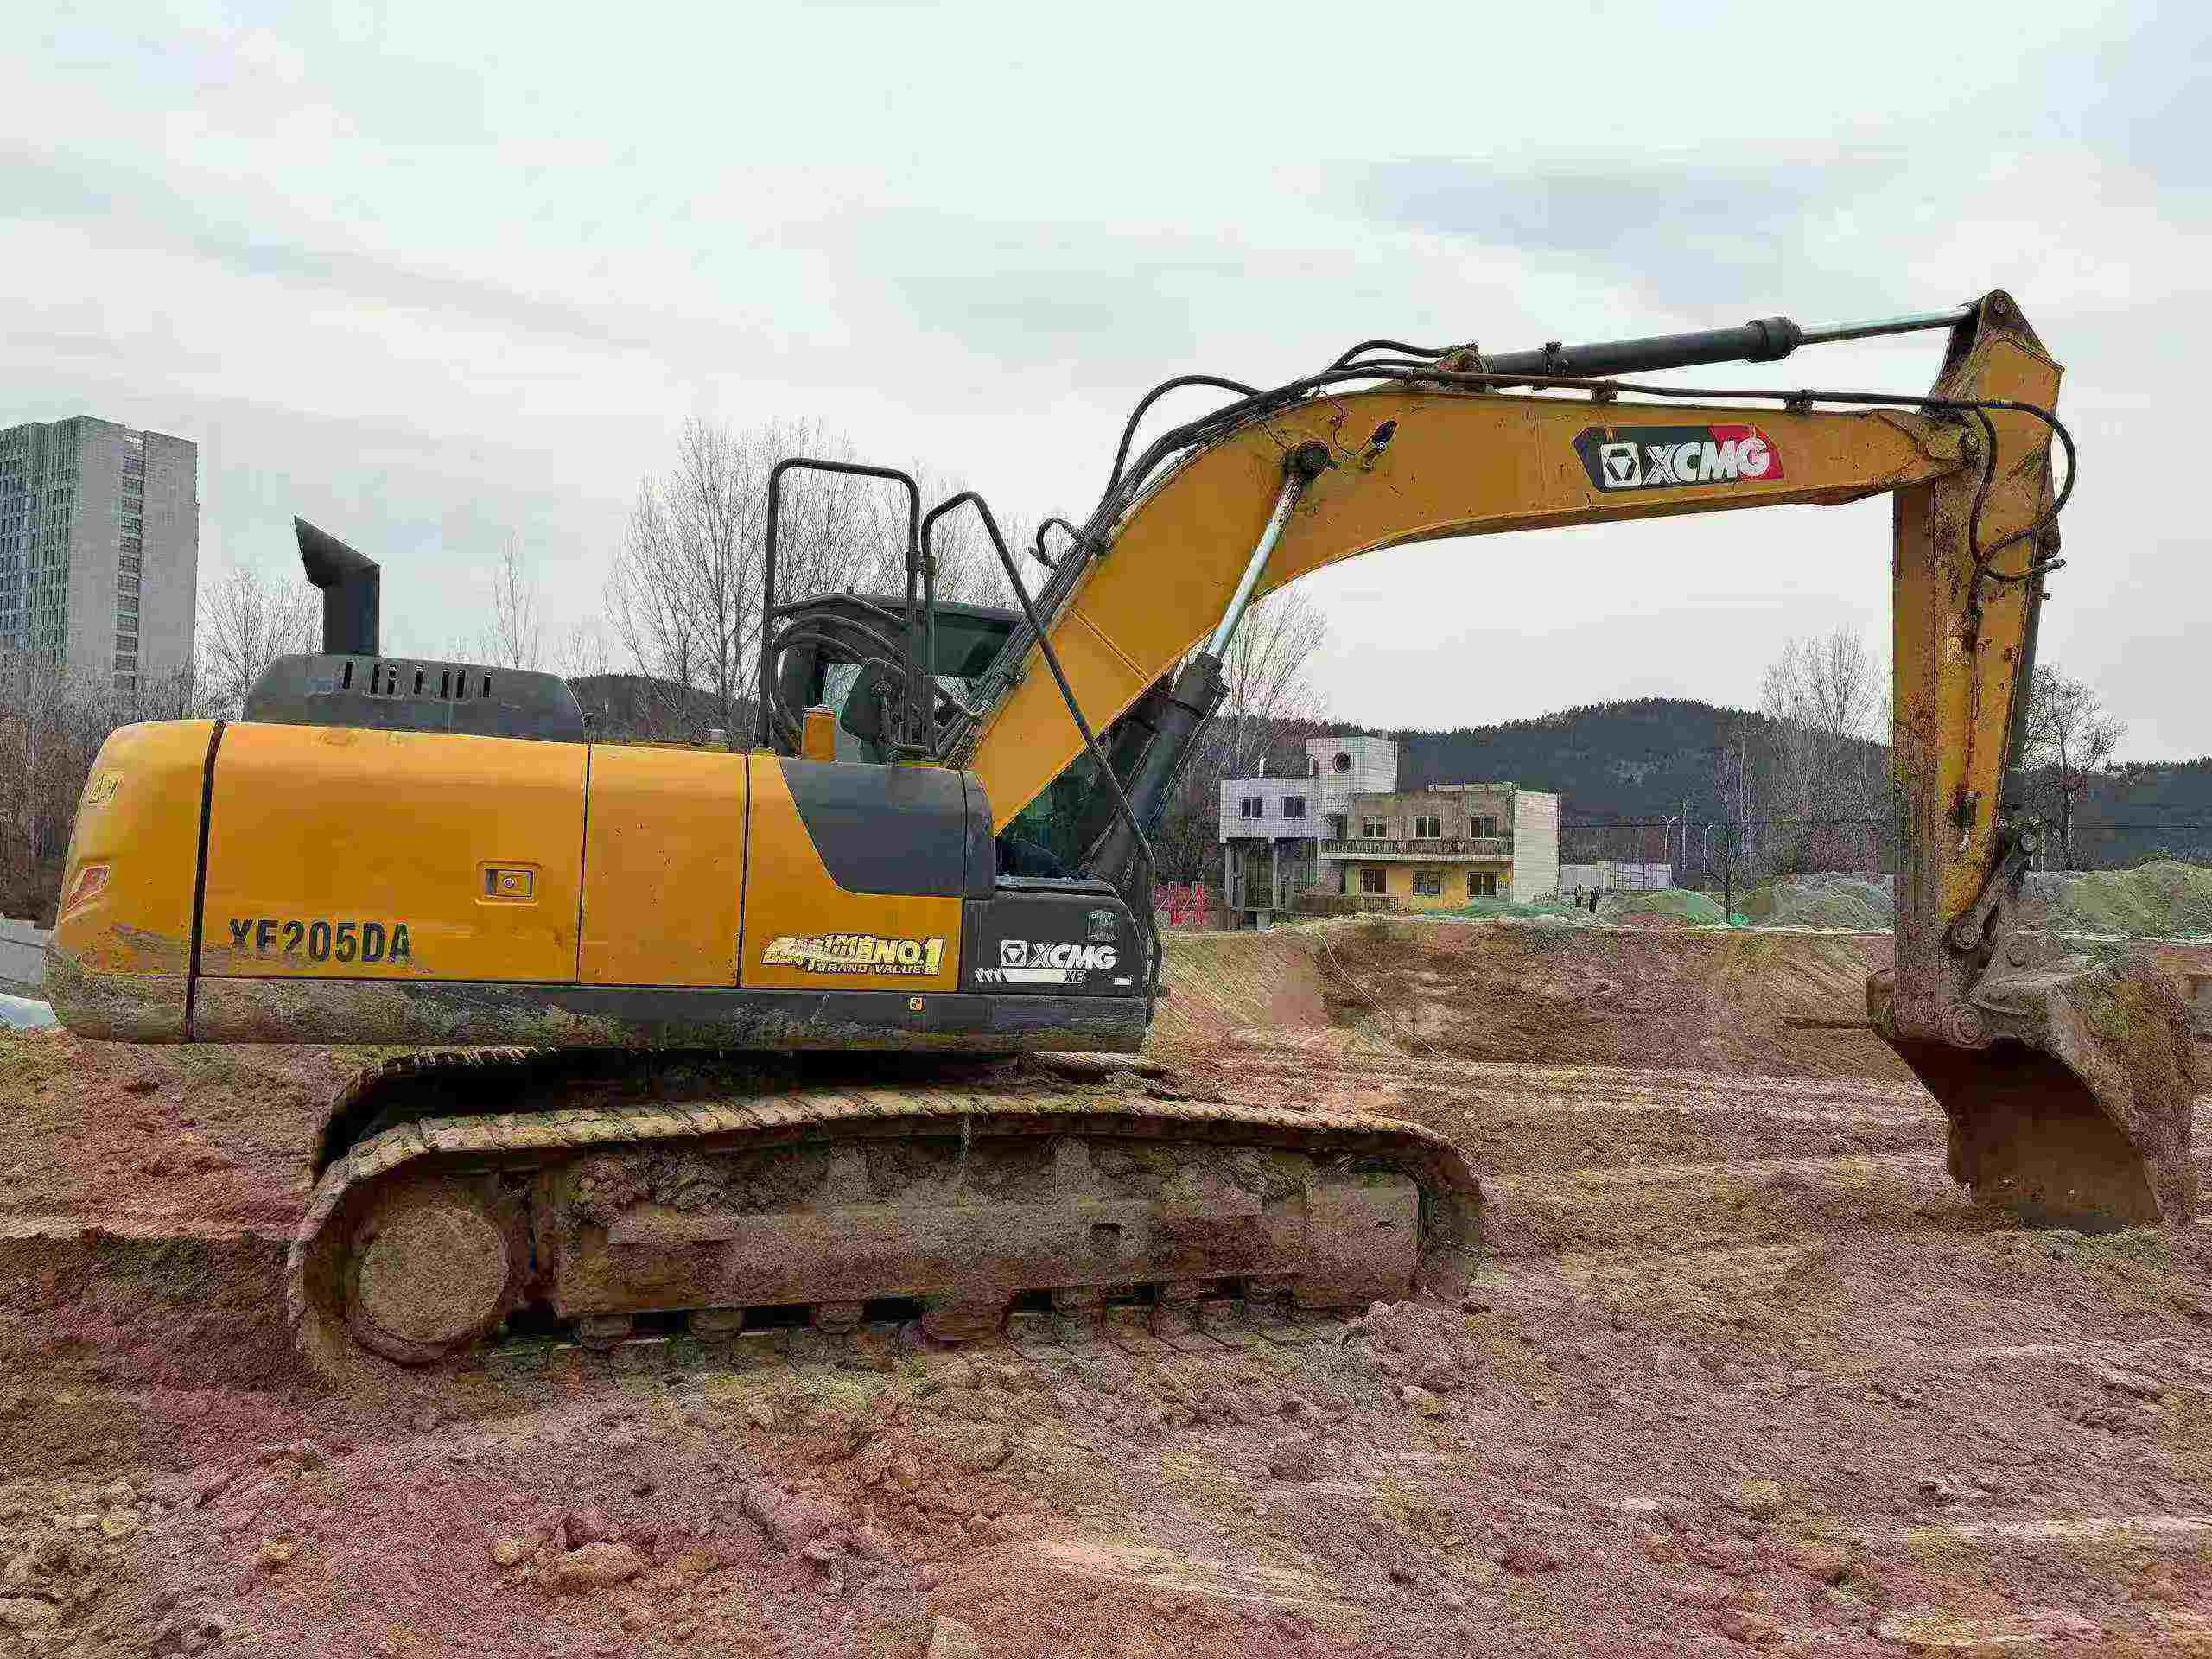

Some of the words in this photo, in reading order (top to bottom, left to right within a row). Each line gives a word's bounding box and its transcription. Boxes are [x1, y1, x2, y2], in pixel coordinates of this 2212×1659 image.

[1643, 437, 1770, 485] XCMG
[815, 963, 869, 973] BRAND
[875, 963, 922, 974] VALUE
[1026, 944, 1117, 969] XCMG
